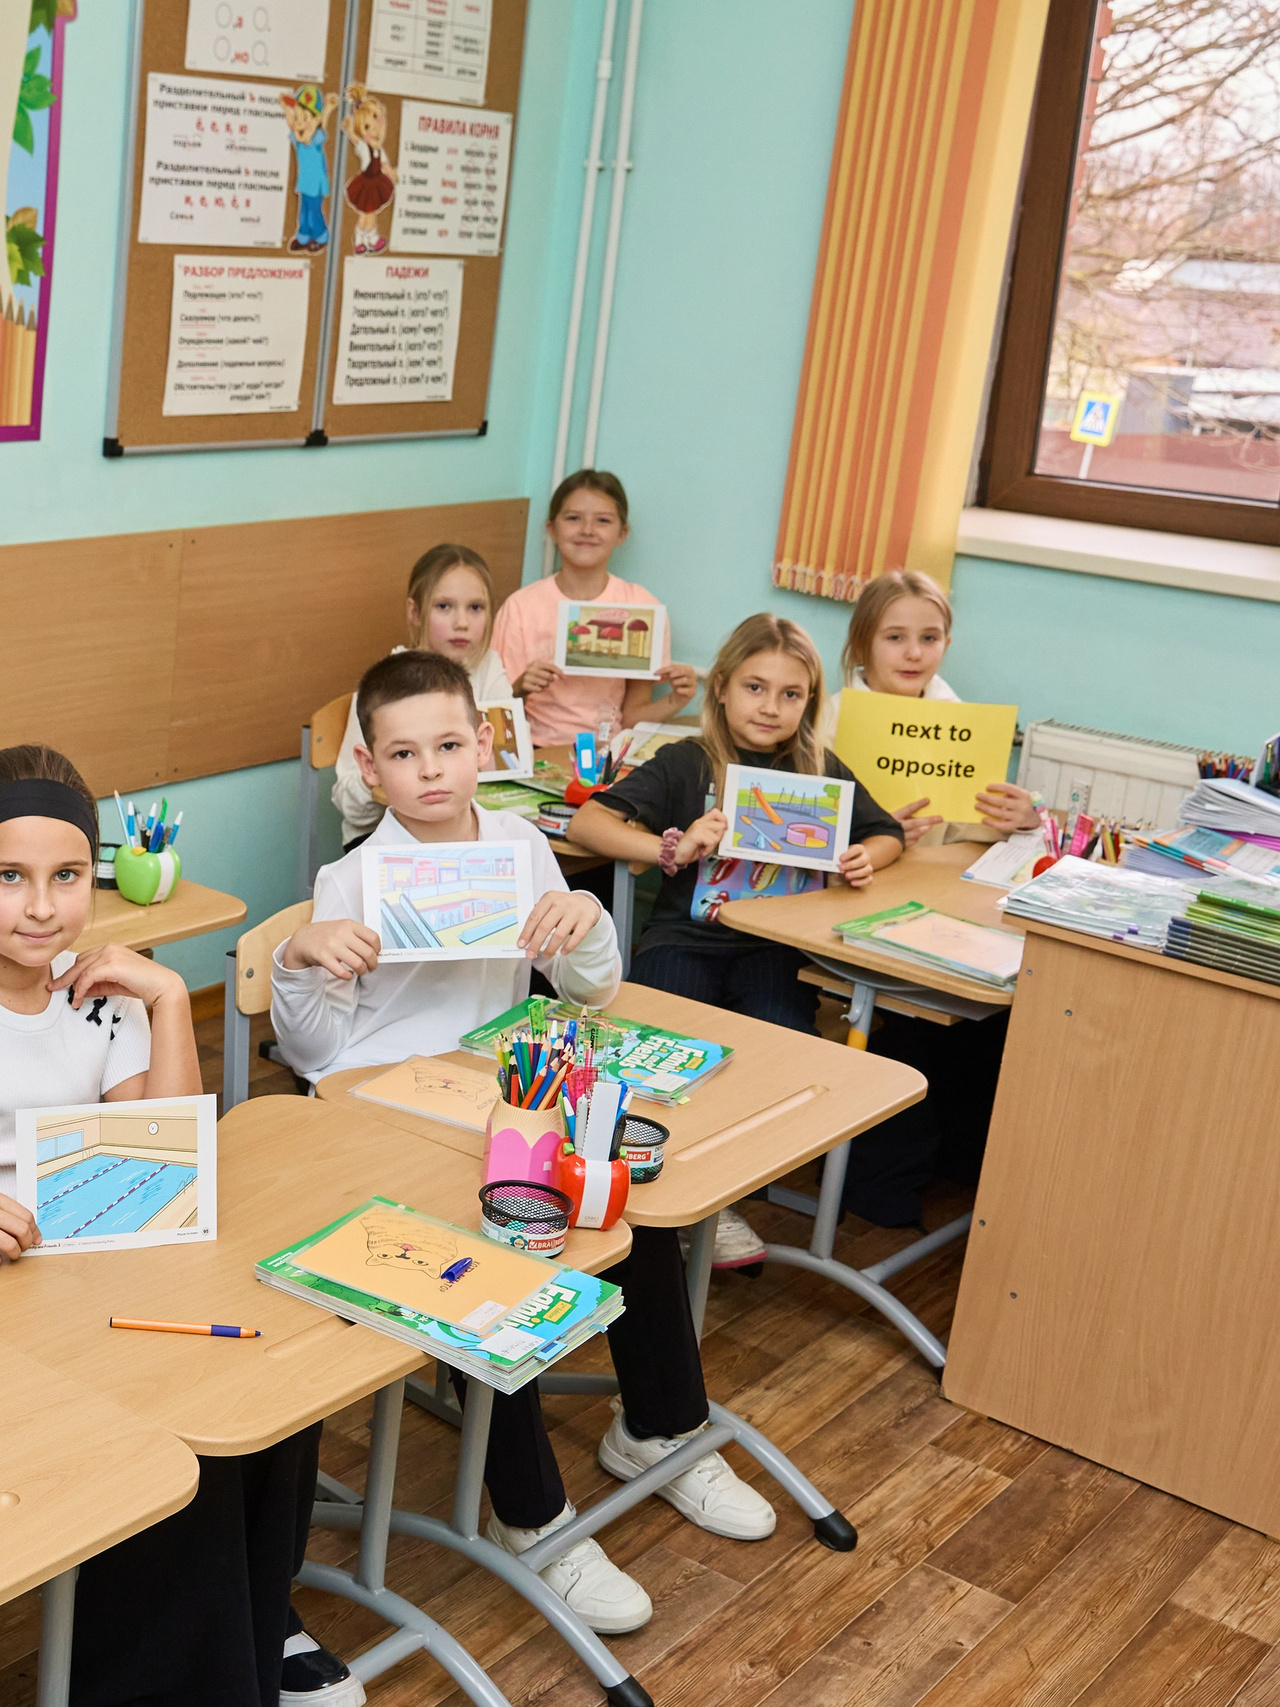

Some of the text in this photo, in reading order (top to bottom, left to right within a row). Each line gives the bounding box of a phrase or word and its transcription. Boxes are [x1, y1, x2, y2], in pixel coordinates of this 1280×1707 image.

[258, 96, 282, 105] посл
[183, 266, 304, 280] РАЗБОР ПРЕДЛОЖЕНИЯ
[385, 265, 431, 279] ПАДЕЖИ
[890, 722, 972, 742] next to
[876, 757, 975, 778] opposite
[618, 1035, 675, 1068] Friends
